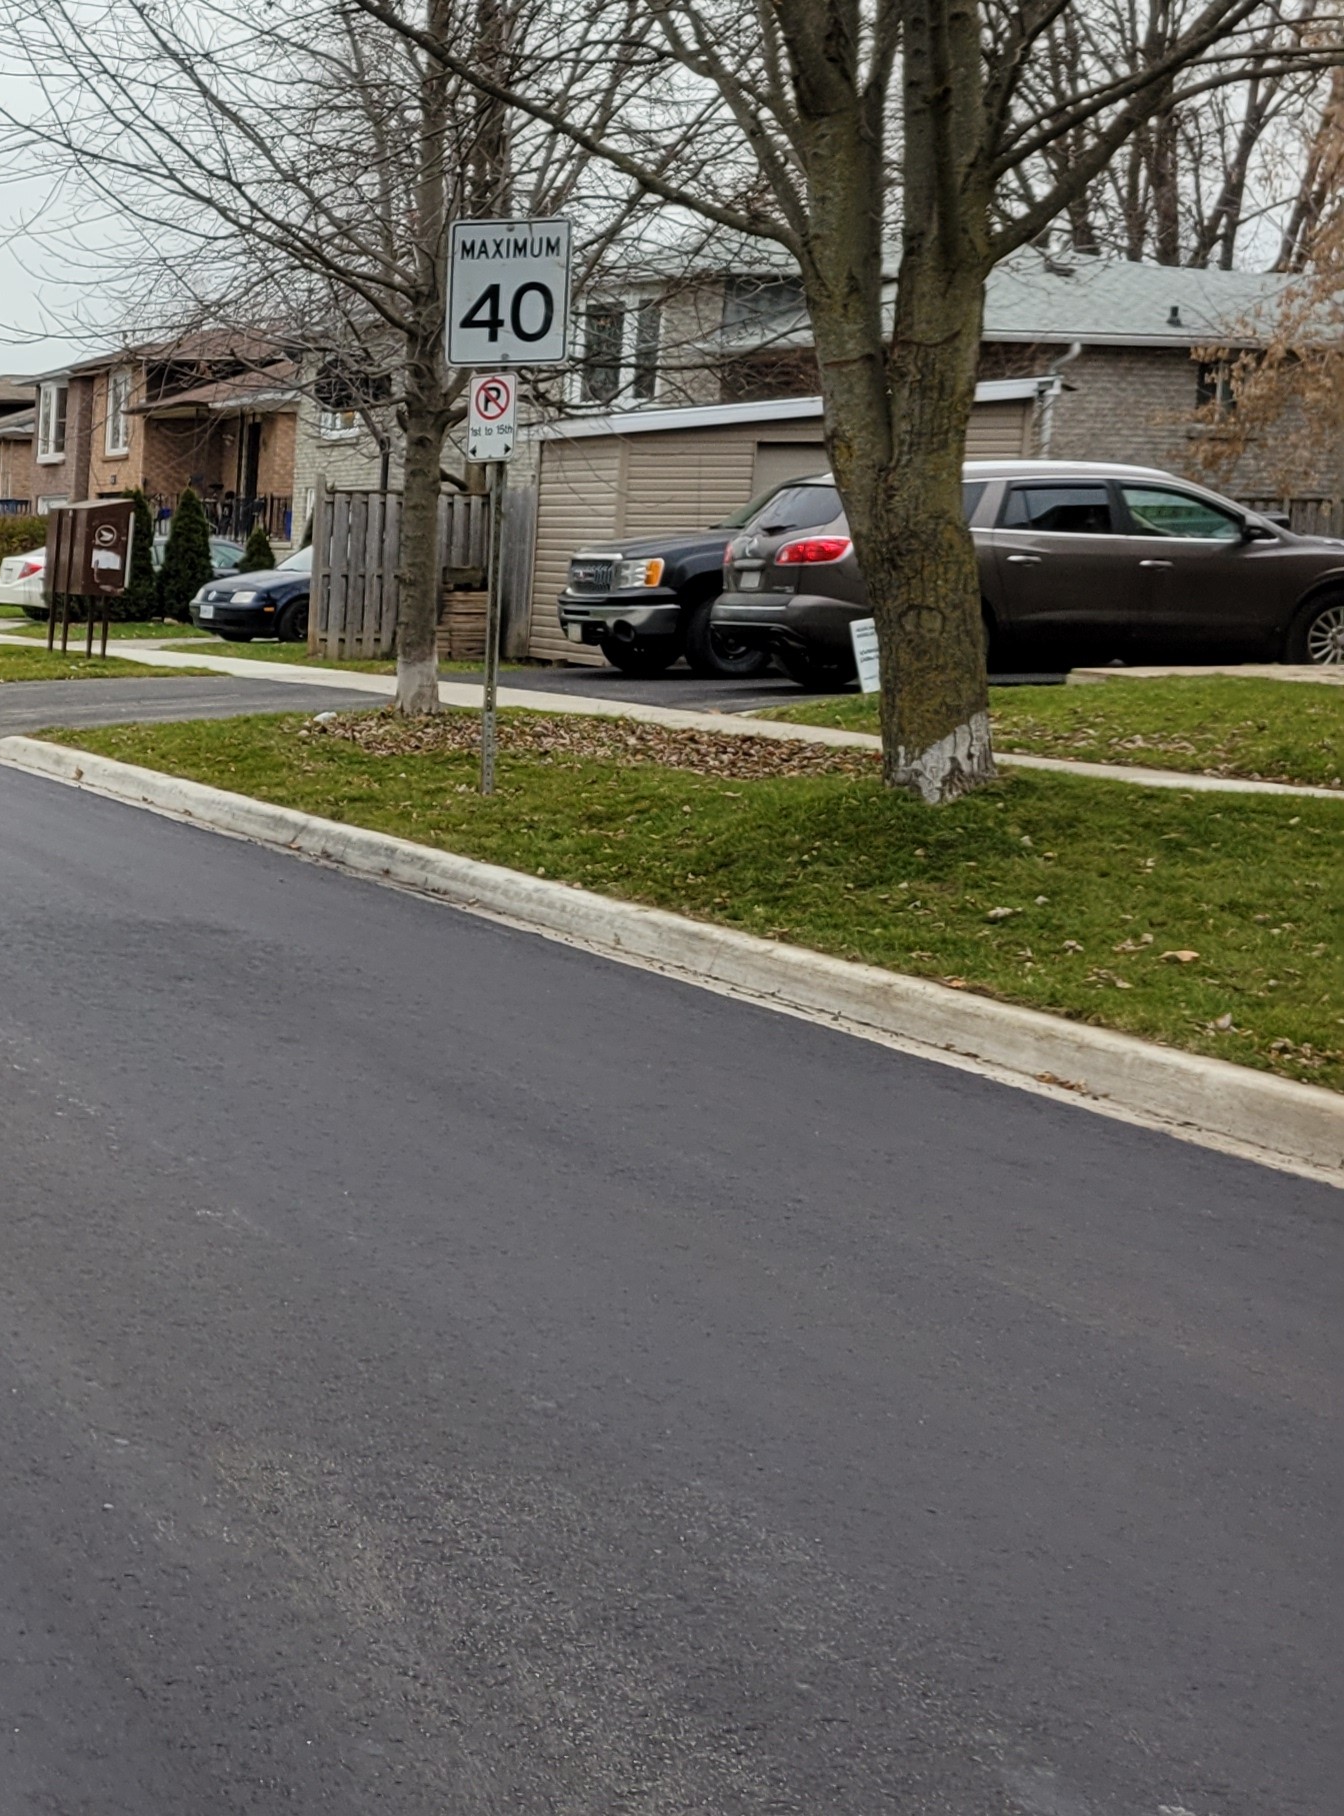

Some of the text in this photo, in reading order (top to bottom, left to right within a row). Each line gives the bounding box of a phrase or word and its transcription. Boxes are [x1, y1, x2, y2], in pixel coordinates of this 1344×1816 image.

[460, 236, 561, 260] MAXIMUM
[459, 281, 554, 342] 40
[483, 386, 501, 412] P
[470, 423, 513, 437] 1st to 15th
